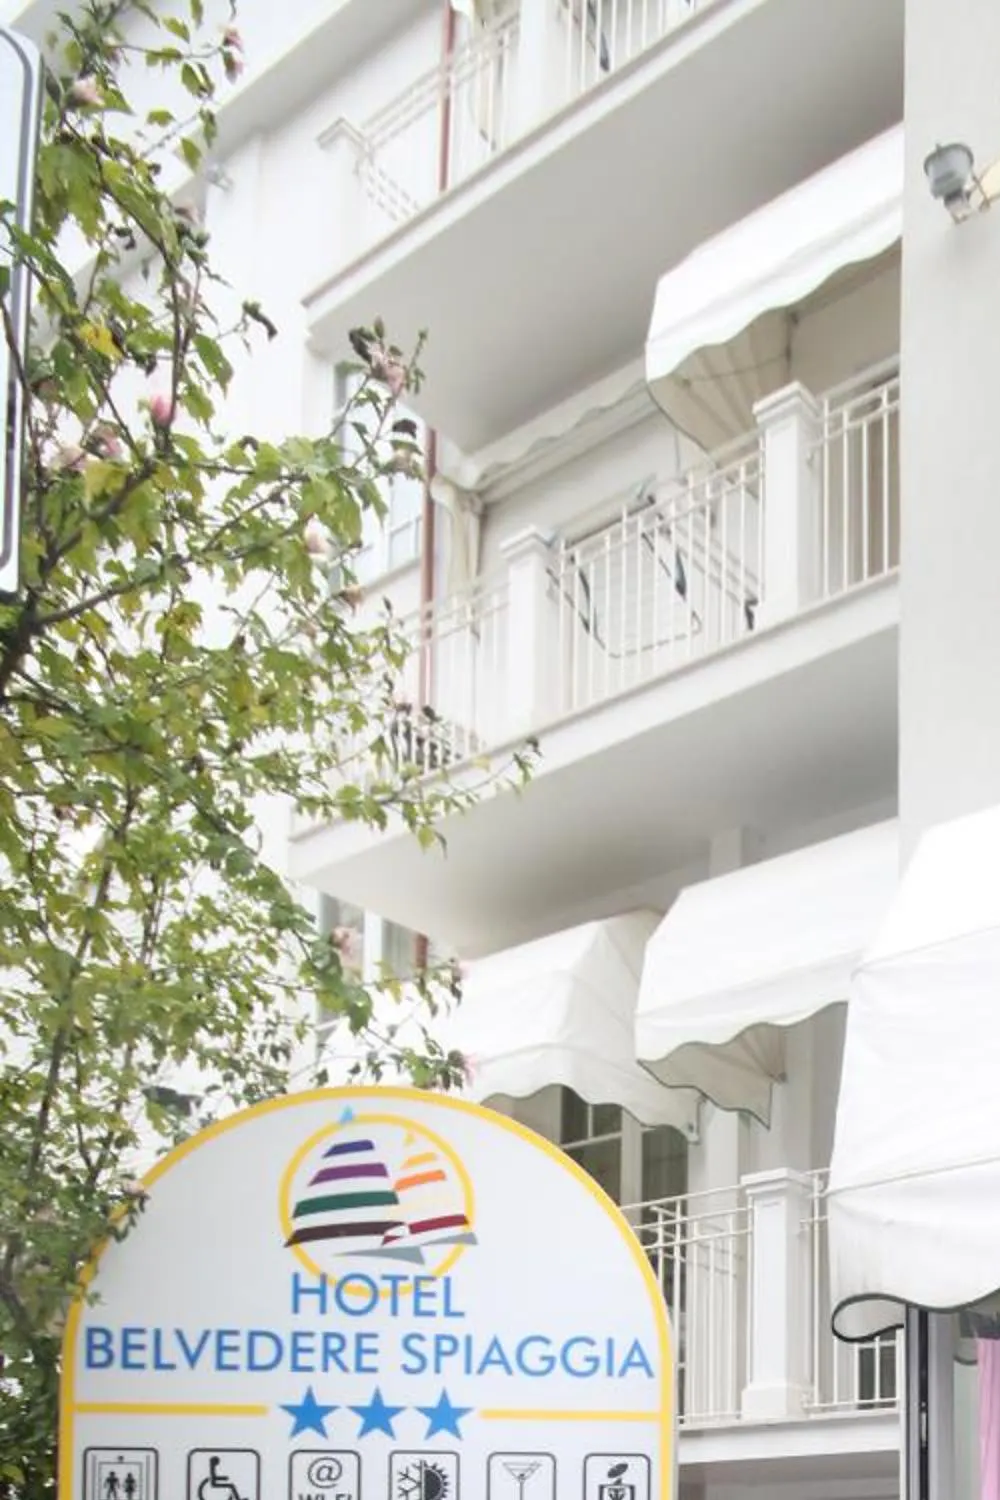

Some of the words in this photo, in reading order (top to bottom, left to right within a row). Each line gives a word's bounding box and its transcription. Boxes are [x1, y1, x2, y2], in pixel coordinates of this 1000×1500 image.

[290, 1271, 465, 1319] HOTEL
[84, 1325, 379, 1375] BELVEDERE
[400, 1332, 655, 1379] SPIAGGIA
